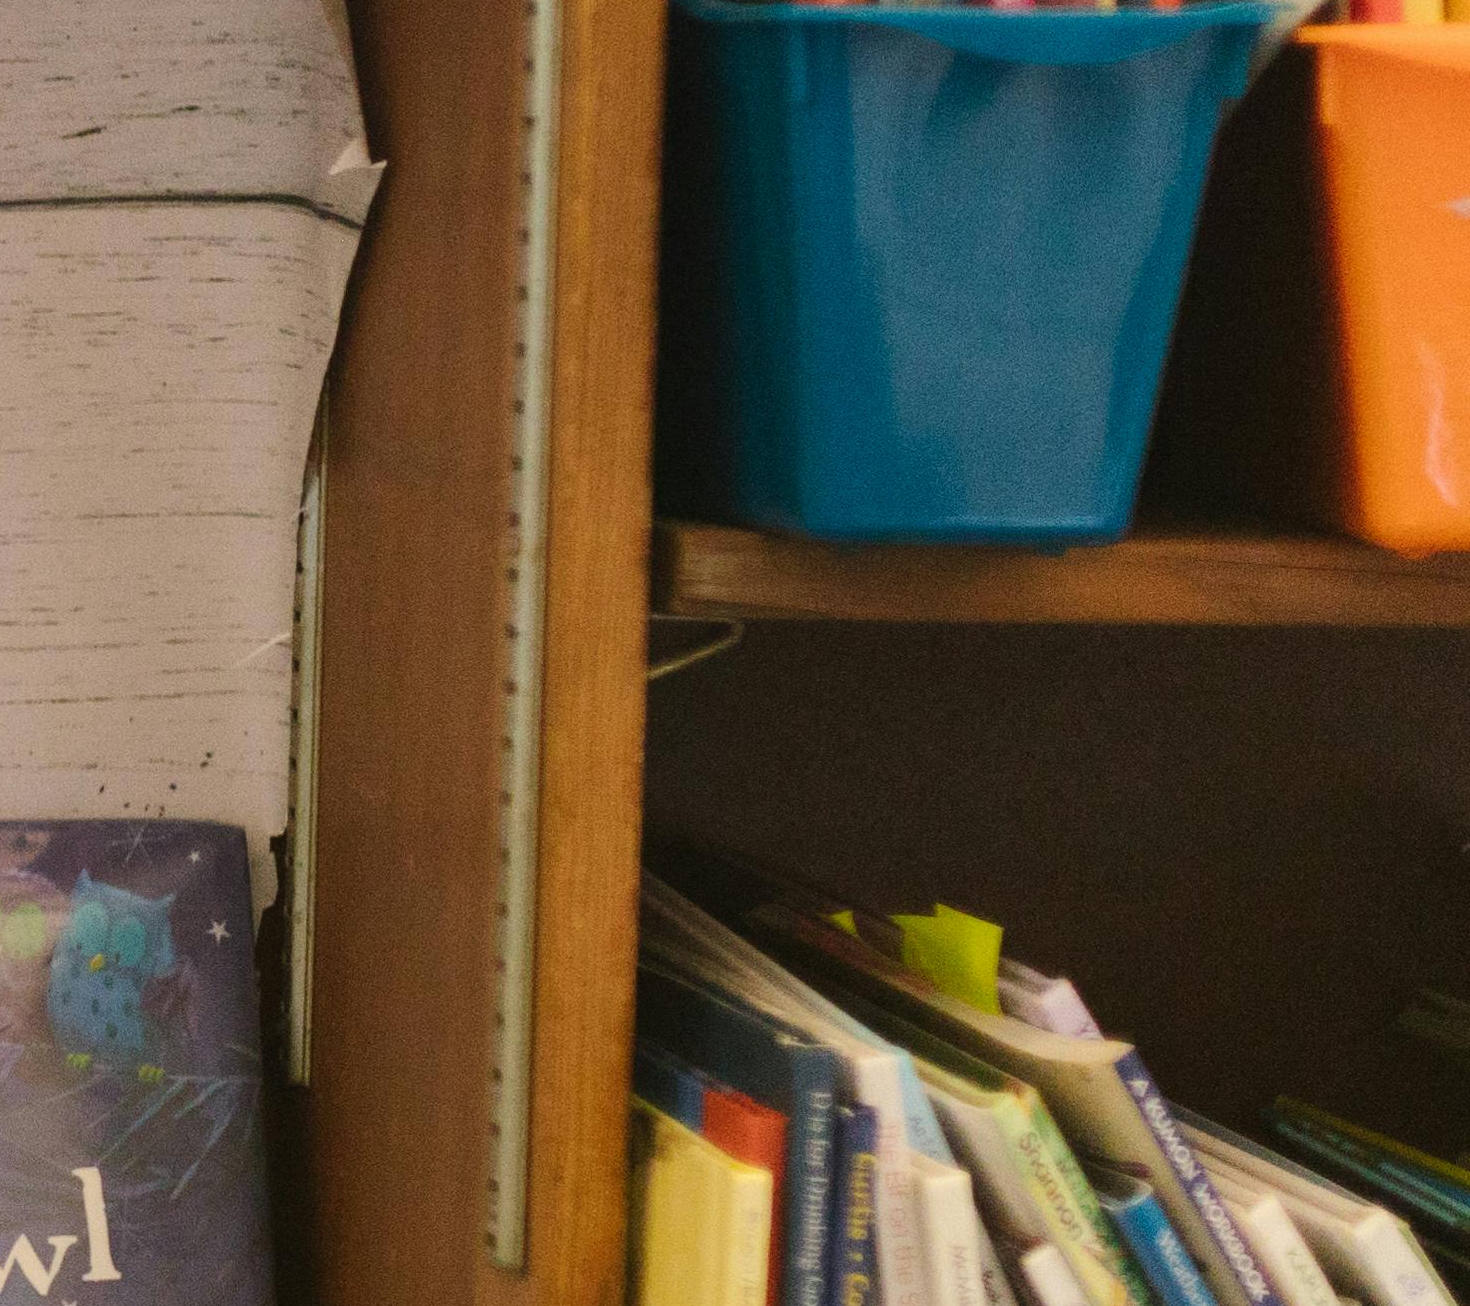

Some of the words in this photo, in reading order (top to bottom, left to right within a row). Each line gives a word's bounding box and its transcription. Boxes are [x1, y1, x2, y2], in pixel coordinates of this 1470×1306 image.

[810, 1091, 832, 1112] D
[810, 1115, 830, 1134] is
[808, 1137, 830, 1169] for
[846, 1150, 877, 1241] Curtis
[882, 1167, 910, 1201] Elf
[1014, 1132, 1089, 1241] Shannon
[1129, 1075, 1152, 1098] A
[1143, 1099, 1198, 1179] KUMON
[1192, 1185, 1269, 1301] WORKBOOK
[796, 1173, 829, 1270] Drinking
[887, 1205, 907, 1236] on
[891, 1243, 917, 1284] the
